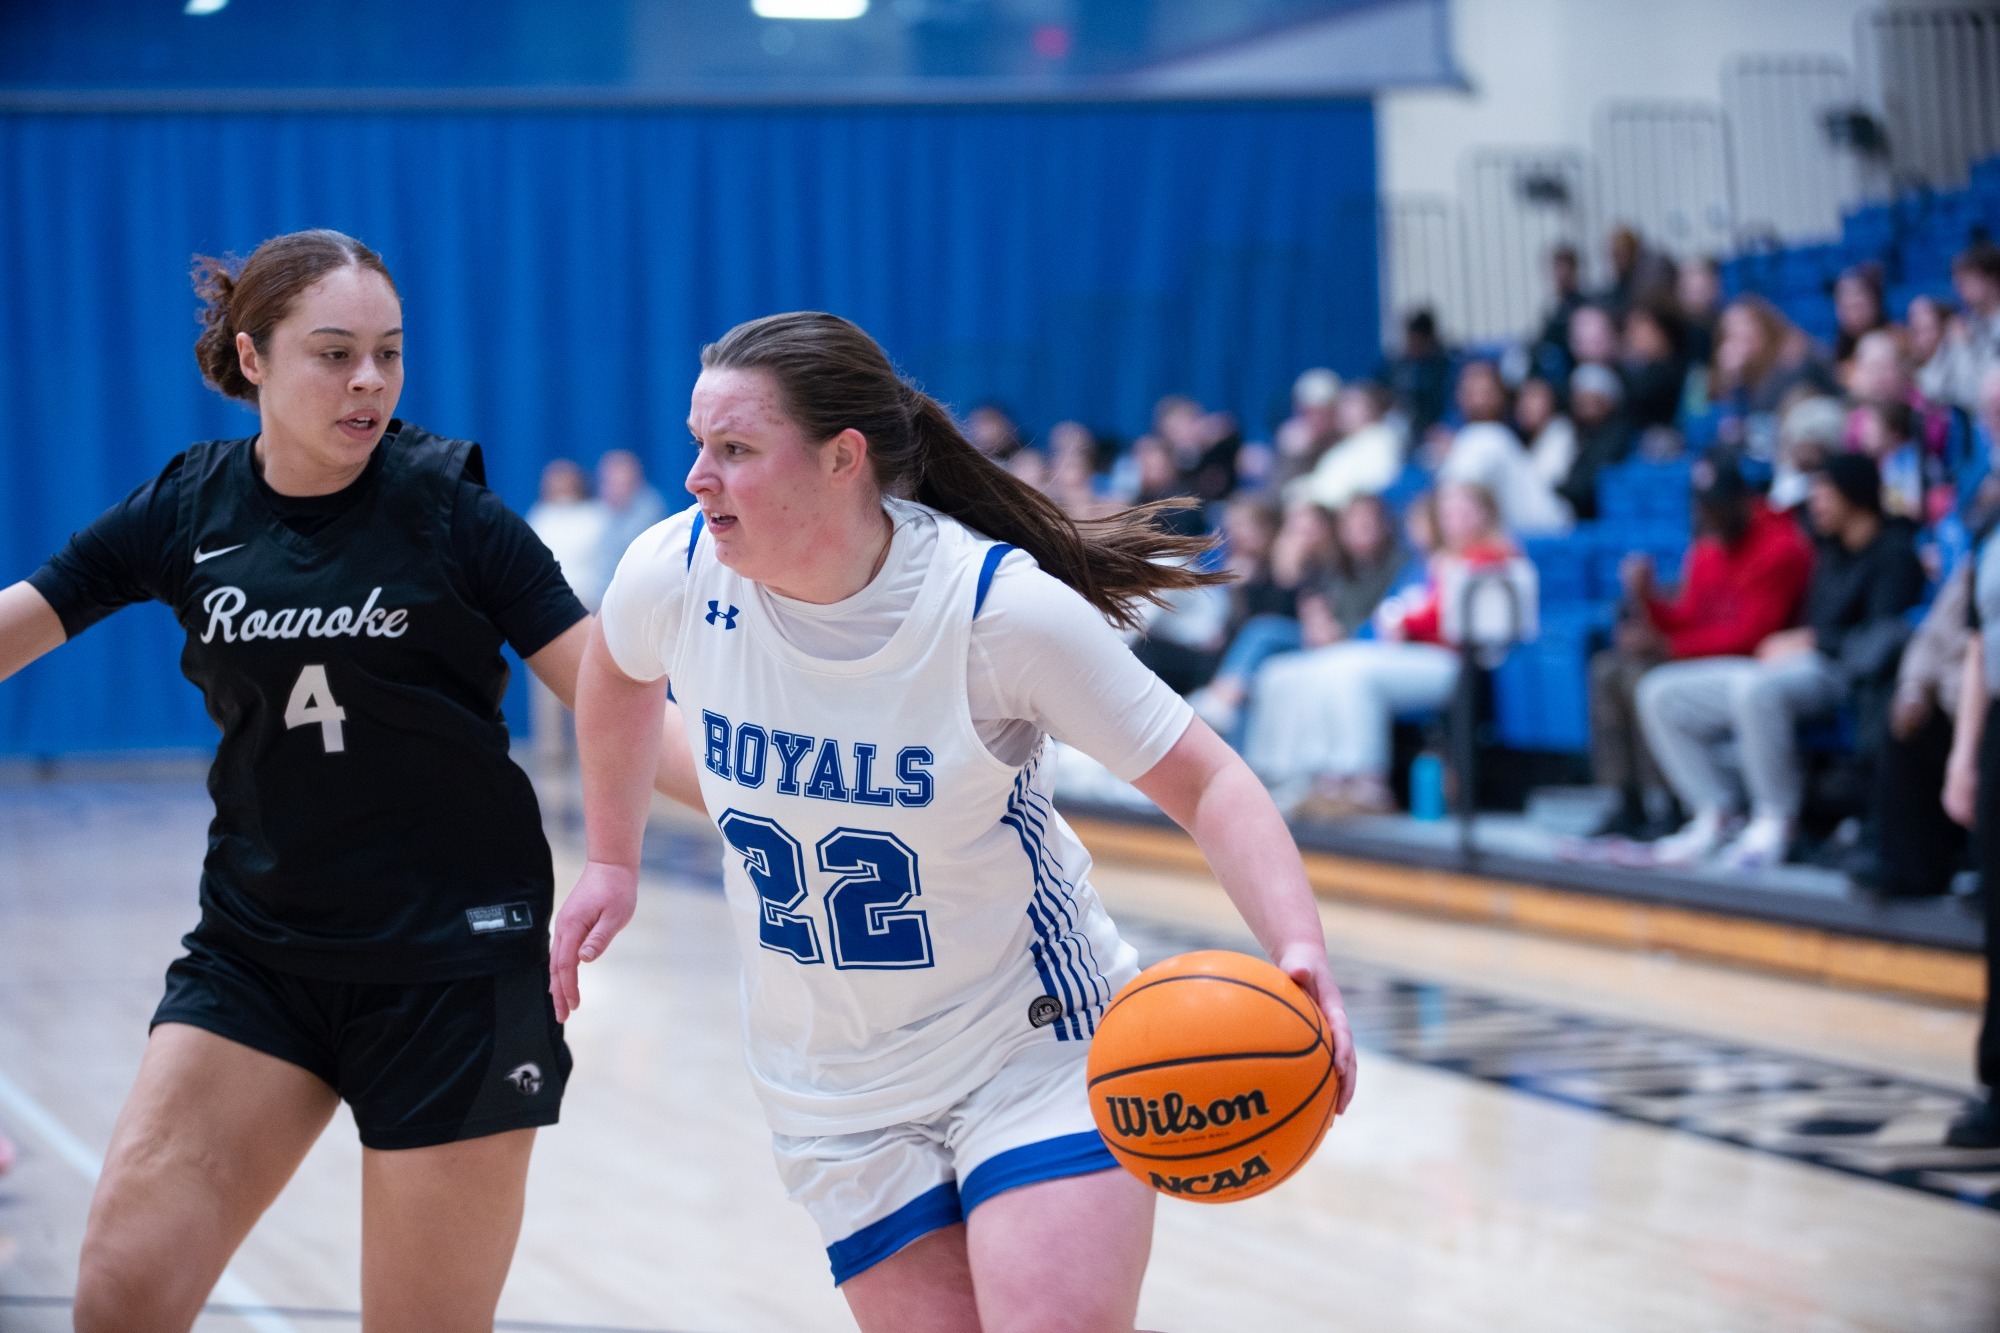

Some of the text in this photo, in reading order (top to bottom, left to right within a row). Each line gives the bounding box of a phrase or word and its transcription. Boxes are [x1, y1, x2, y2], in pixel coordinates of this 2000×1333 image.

[201, 586, 408, 644] Roanoke
[284, 664, 346, 753] 4
[702, 708, 934, 808] ROYALS
[512, 909, 522, 922] L
[717, 807, 935, 971] 22
[1105, 1089, 1270, 1138] Wilson
[1148, 1155, 1272, 1195] NCAA
